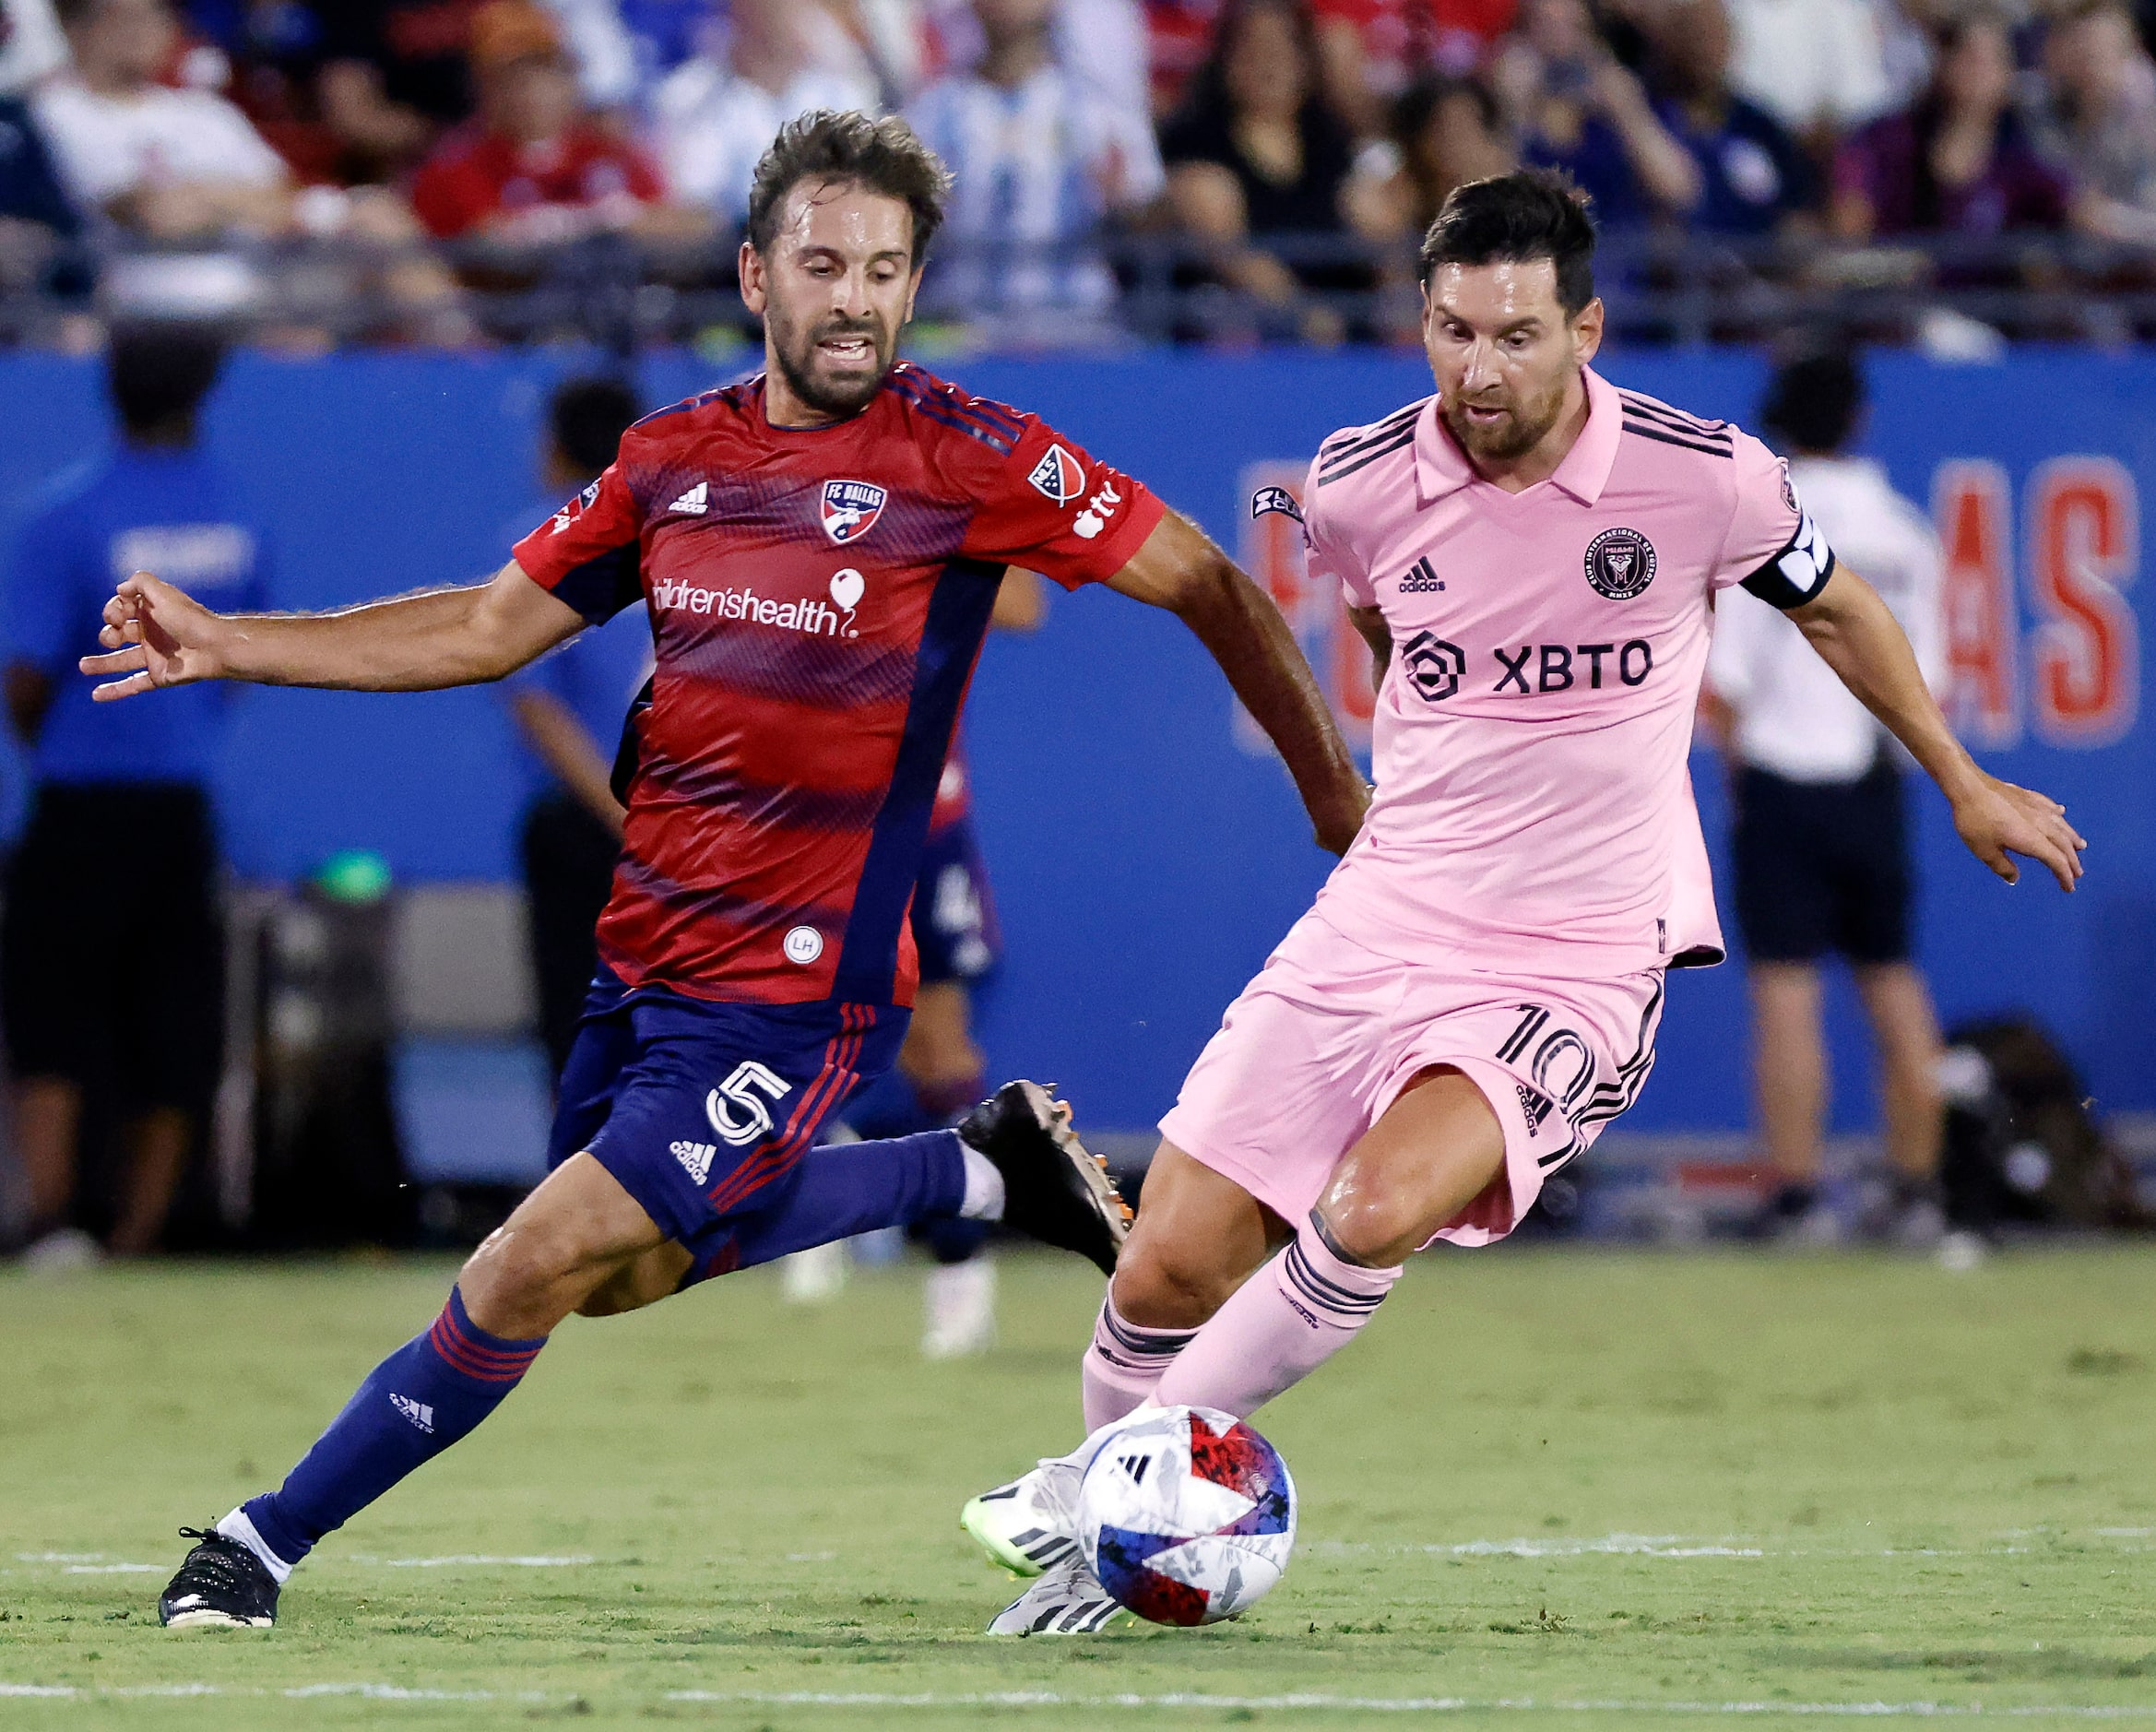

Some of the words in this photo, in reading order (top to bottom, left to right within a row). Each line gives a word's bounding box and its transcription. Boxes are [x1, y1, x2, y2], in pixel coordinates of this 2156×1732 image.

[1034, 458, 1057, 485] MLS
[827, 483, 844, 499] FC
[843, 484, 882, 507] DALLAS
[1642, 541, 1653, 552] DE
[1399, 577, 1446, 593] adidas
[1492, 639, 1653, 694] XBTO
[792, 937, 814, 952] LH
[1495, 1003, 1595, 1115] 10
[705, 1061, 793, 1146] 5
[1515, 1085, 1538, 1138] adidas
[669, 1141, 708, 1186] adidas
